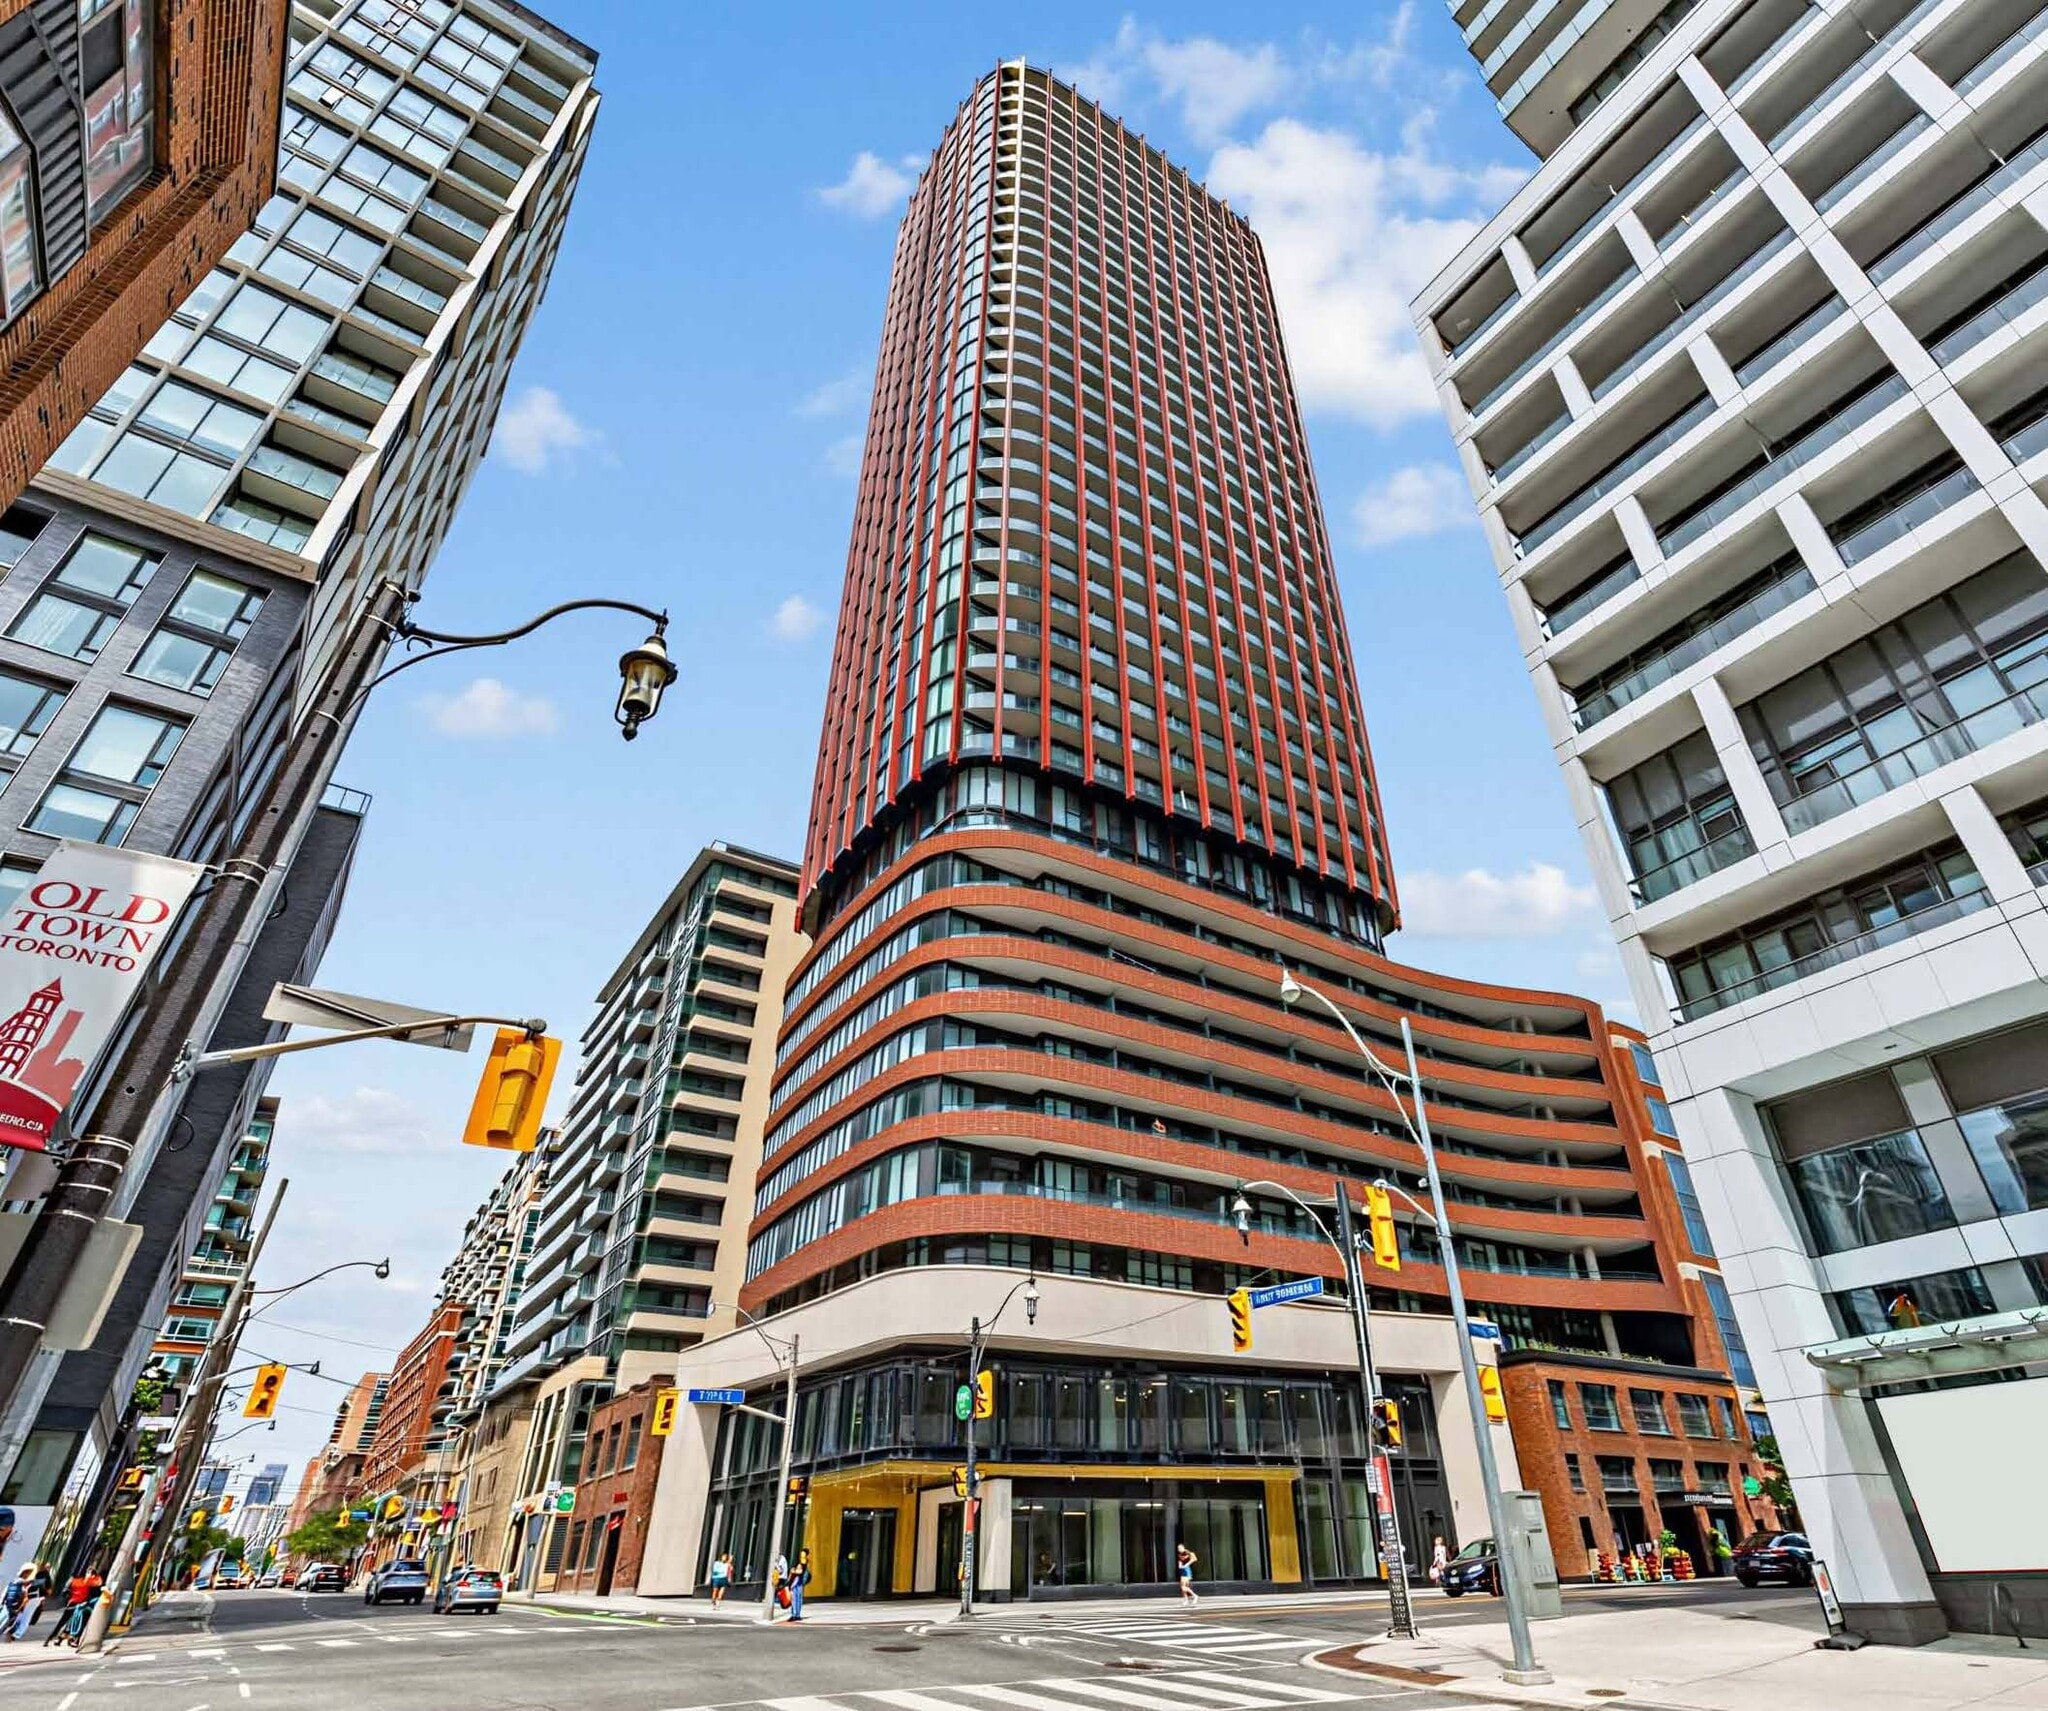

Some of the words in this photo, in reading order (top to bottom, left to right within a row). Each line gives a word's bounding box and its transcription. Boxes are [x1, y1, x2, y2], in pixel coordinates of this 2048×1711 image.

[30, 881, 170, 925] OLD
[13, 908, 153, 953] TOWN
[0, 934, 136, 972] TORONTO
